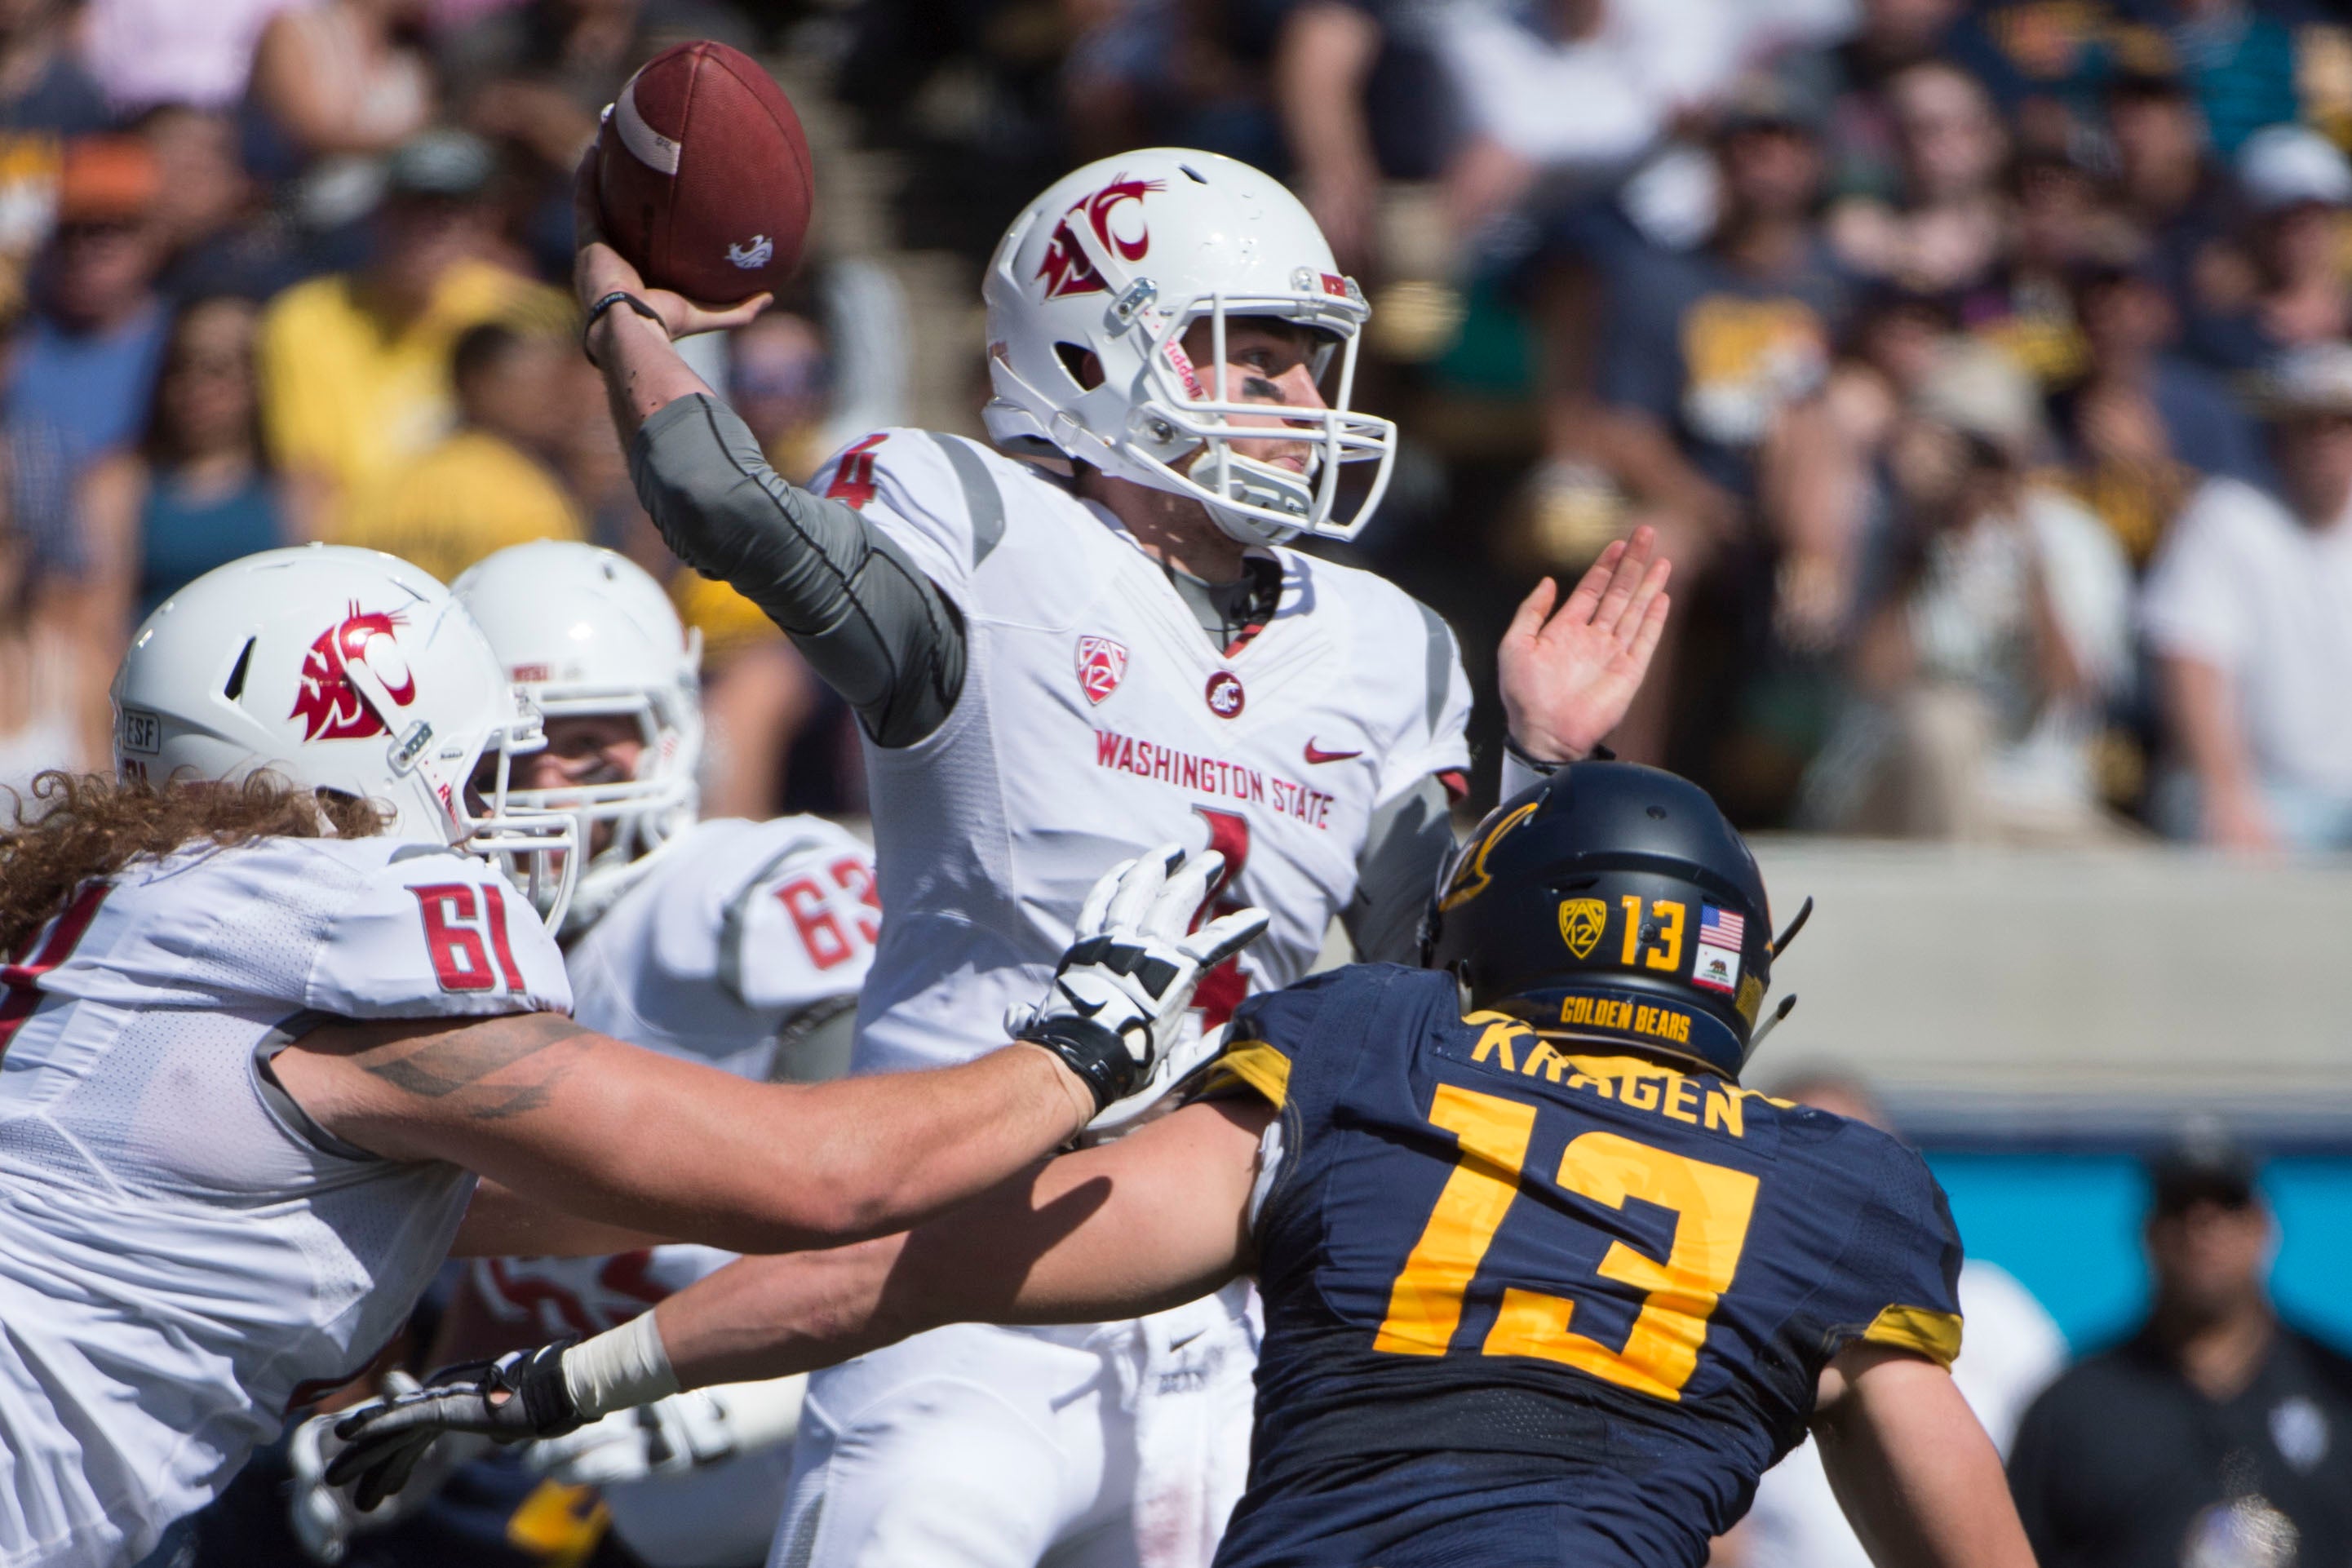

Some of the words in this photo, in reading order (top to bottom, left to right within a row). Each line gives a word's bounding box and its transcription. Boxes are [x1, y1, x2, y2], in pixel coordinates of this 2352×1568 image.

[824, 432, 889, 511] 4
[1078, 636, 1127, 683] PAC
[1086, 665, 1114, 693] 12
[126, 715, 154, 746] ESF
[1095, 729, 1265, 804] WASHINGTON
[1272, 777, 1335, 830] STATE
[403, 881, 527, 994] 61
[773, 857, 884, 971] 63
[1563, 901, 1604, 935] PAC
[1570, 924, 1593, 946] 12
[1620, 895, 1686, 972] 13
[1560, 995, 1633, 1030] GOLDEN
[1634, 1004, 1692, 1044] BEARS
[1470, 1020, 1744, 1139] KRAGEN
[1372, 1083, 1761, 1402] 13
